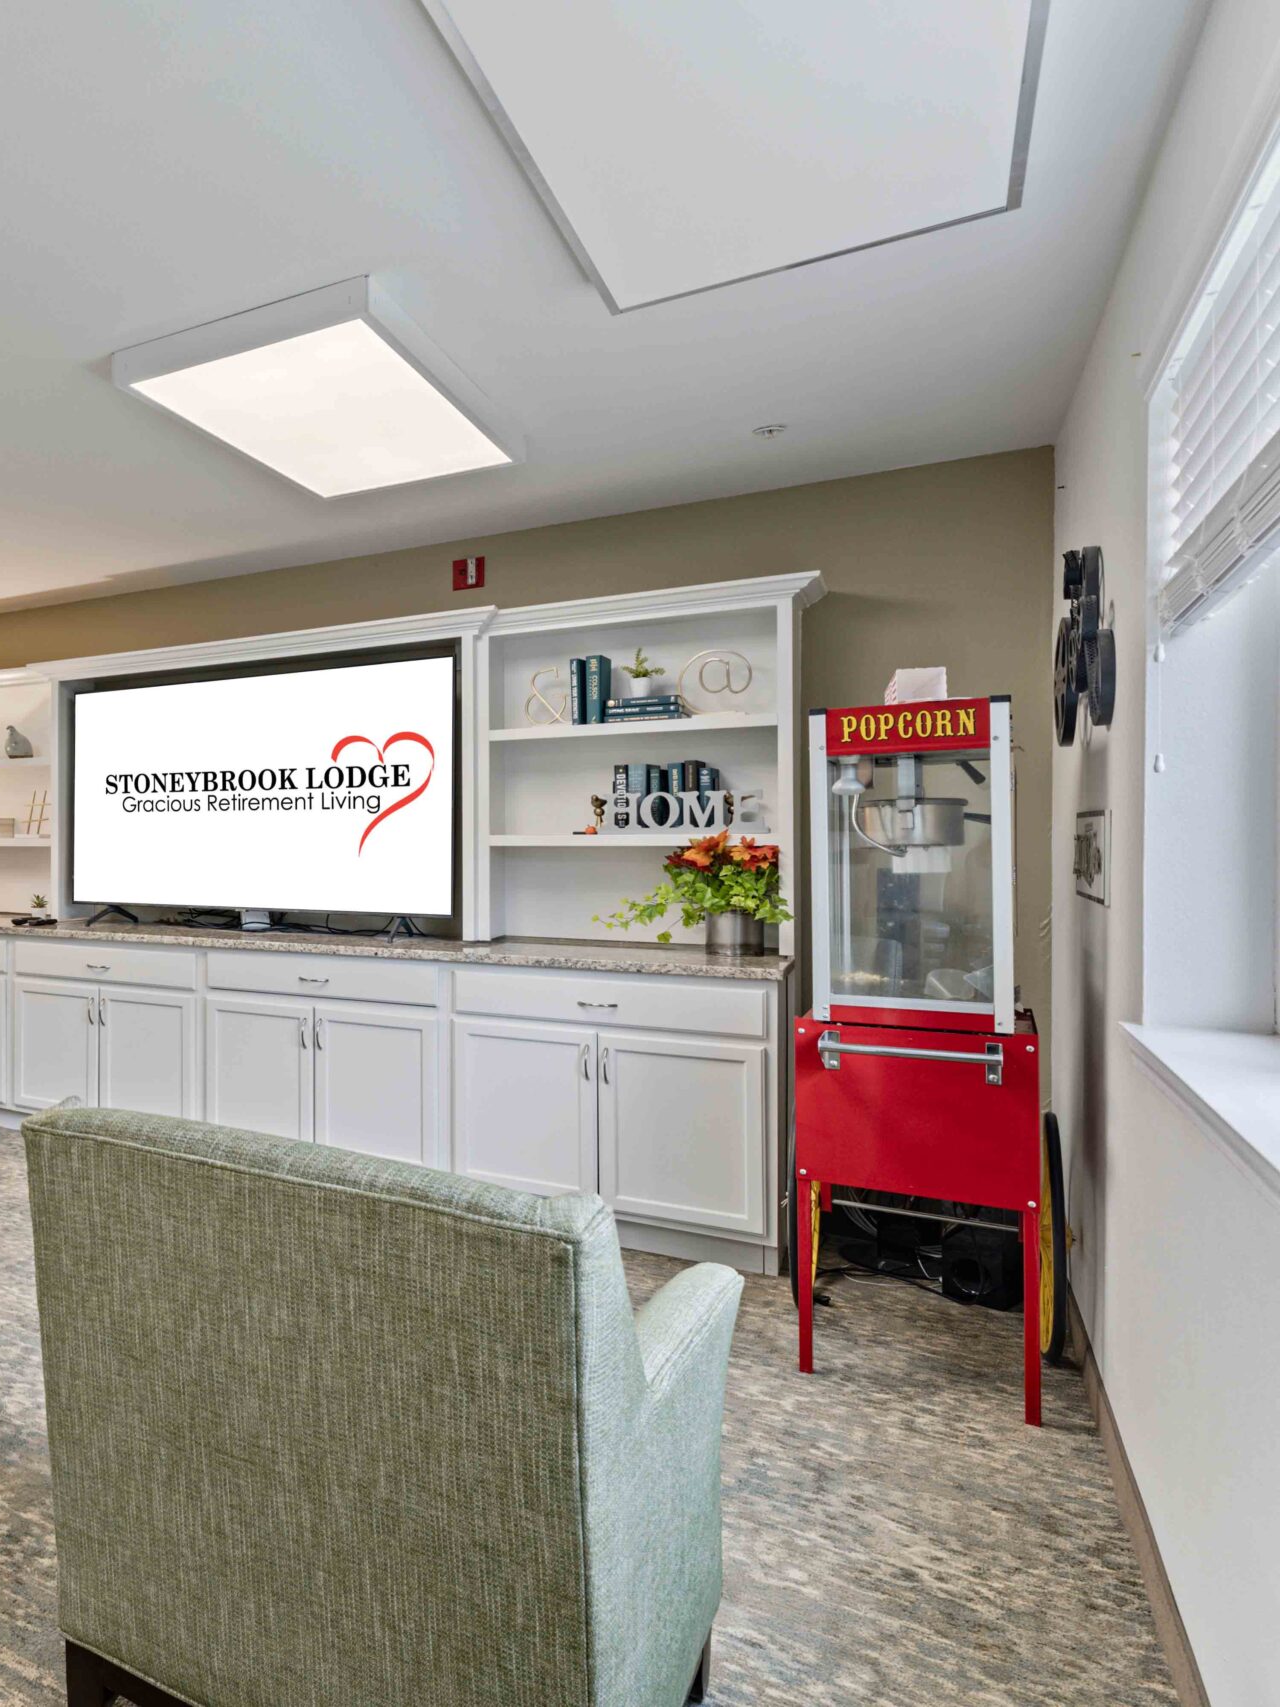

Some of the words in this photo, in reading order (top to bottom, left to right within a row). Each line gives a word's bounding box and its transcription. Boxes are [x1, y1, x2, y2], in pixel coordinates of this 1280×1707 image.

[840, 708, 977, 743] POPCORN
[105, 768, 299, 795] STONEYBROOK
[305, 764, 411, 789] LODGE
[616, 774, 627, 820] DEVOTIOS
[122, 795, 201, 813] Gracious
[207, 793, 314, 812] Retirement
[321, 791, 381, 814] Living
[603, 790, 765, 828] HOME
